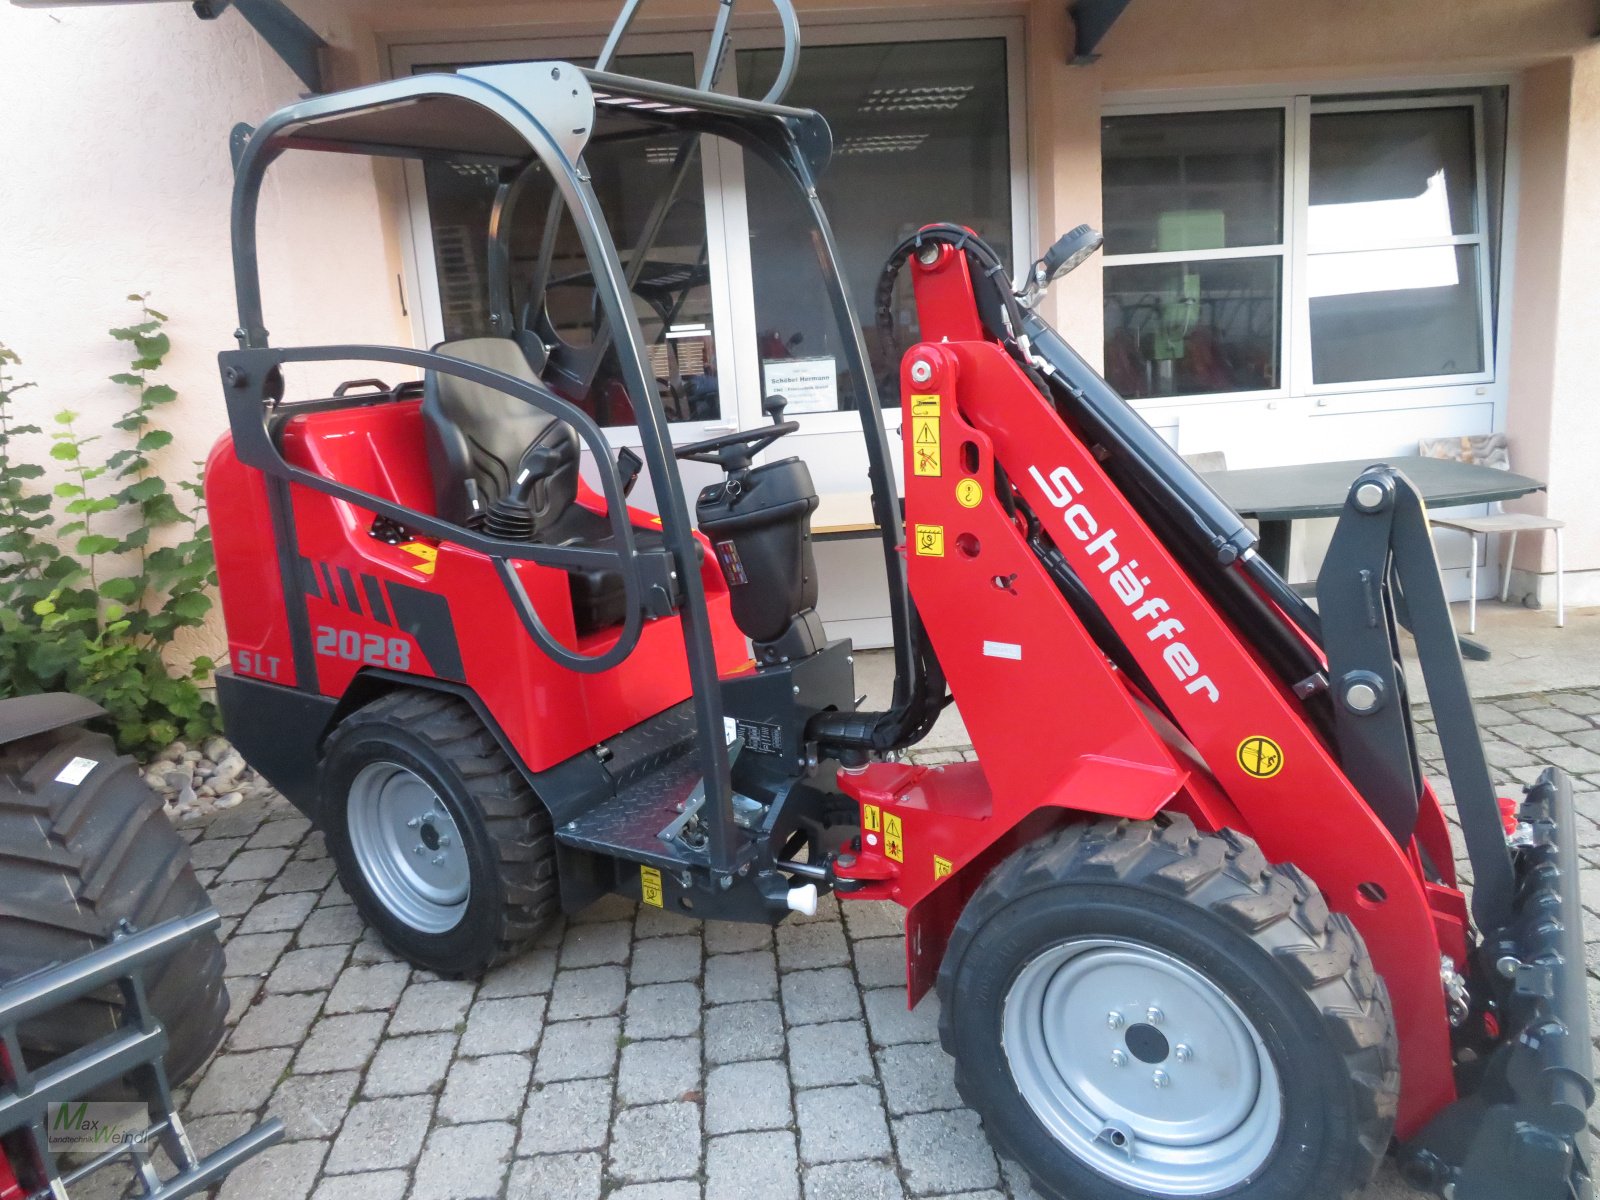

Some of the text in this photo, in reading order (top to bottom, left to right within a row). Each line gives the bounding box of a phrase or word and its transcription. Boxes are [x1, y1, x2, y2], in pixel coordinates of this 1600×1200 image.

[1028, 465, 1220, 703] Schäffer
[238, 650, 280, 679] SLT
[317, 625, 410, 671] 2028
